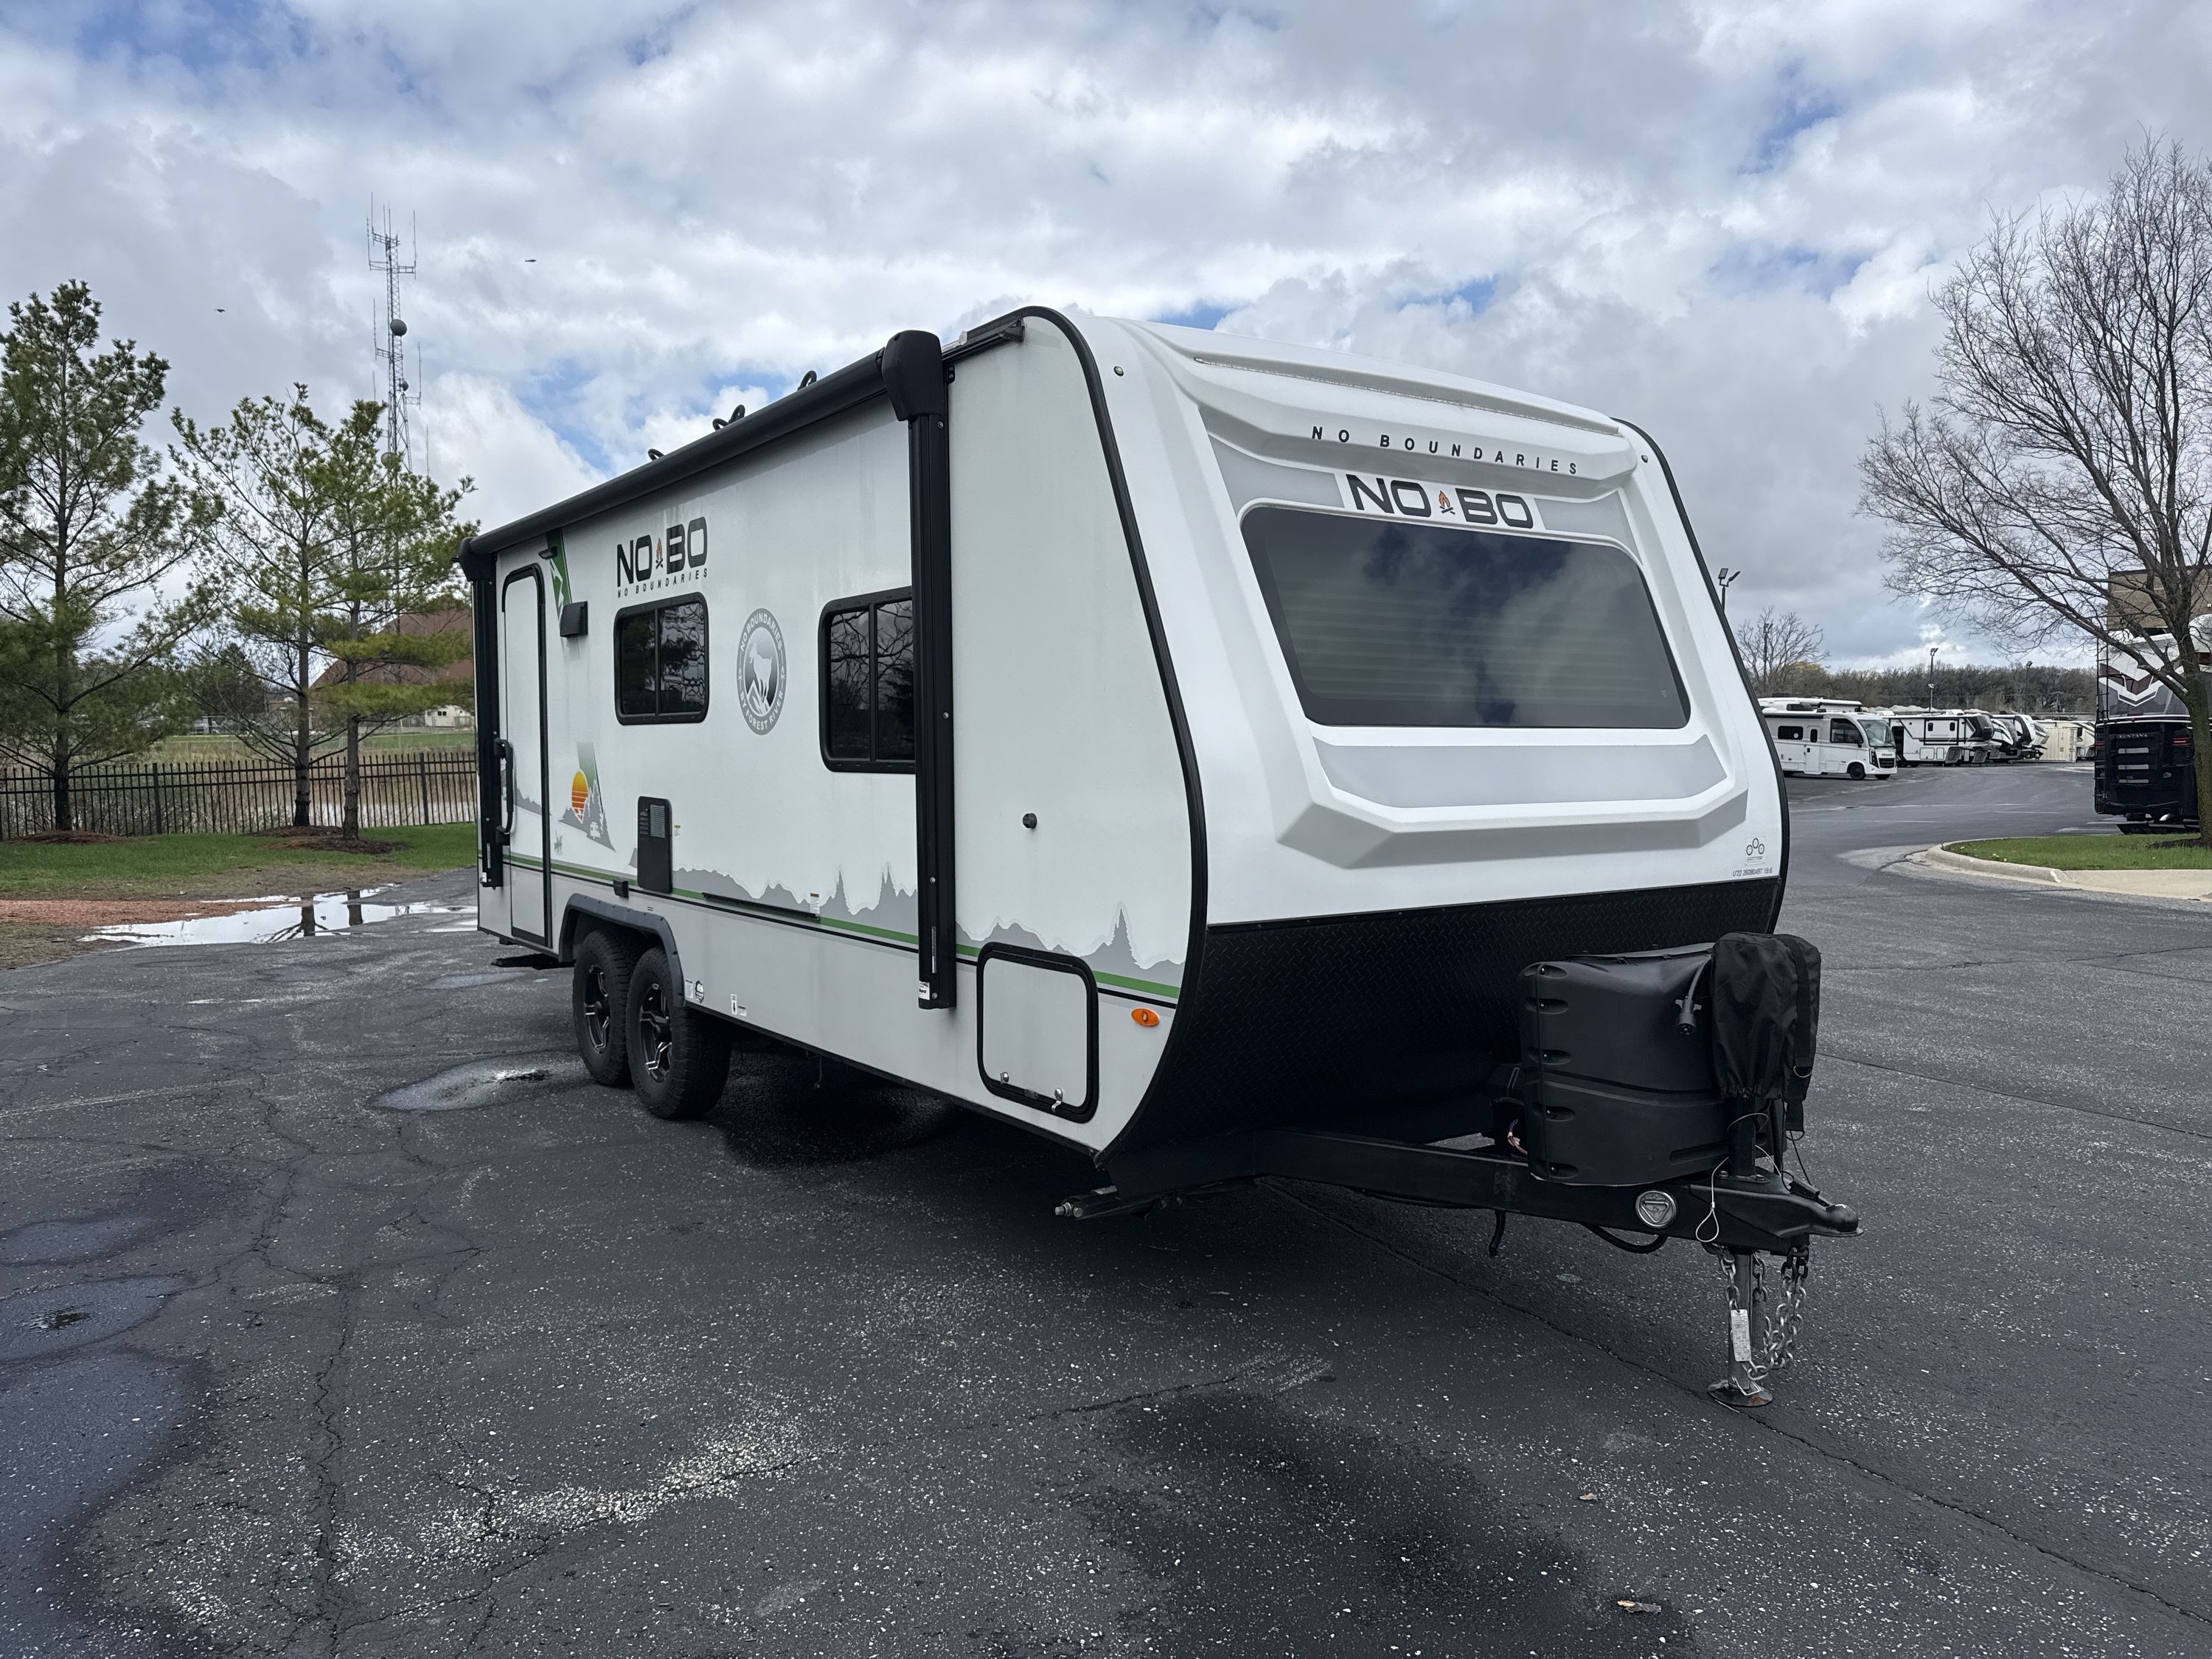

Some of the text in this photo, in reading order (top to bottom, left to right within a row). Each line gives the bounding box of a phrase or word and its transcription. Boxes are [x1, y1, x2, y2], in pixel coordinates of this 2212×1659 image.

[1311, 426, 1577, 475] NO BOUNDARIES
[617, 568, 708, 598] NO BOUNDARIES
[740, 612, 782, 652] NO BOUNDARIES
[740, 690, 783, 731] BY FOREST RIVER
